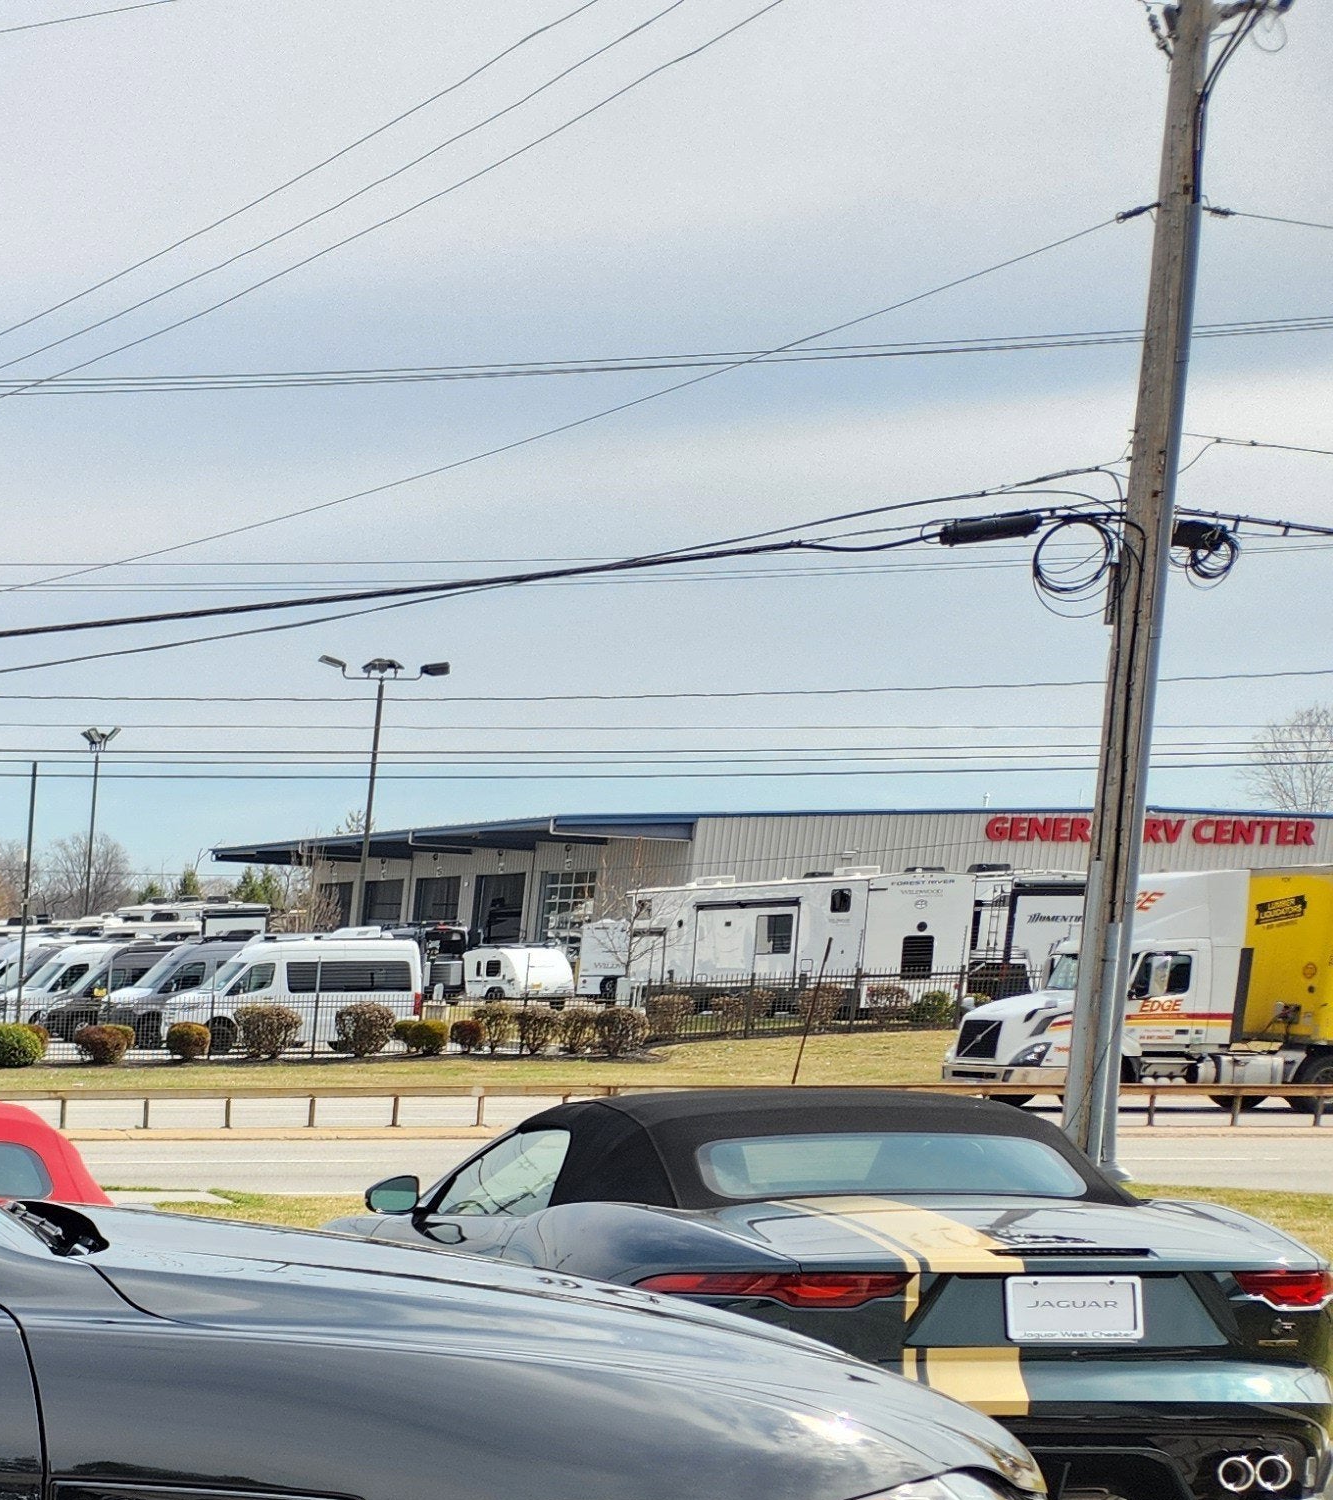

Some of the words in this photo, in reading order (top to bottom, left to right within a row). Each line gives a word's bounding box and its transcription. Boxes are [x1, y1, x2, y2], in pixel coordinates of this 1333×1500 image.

[985, 816, 1091, 842] GENER
[1191, 819, 1315, 846] CENTER
[1139, 999, 1183, 1013] EDGE
[1027, 1300, 1118, 1309] JAGUAR
[1020, 1331, 1057, 1339] Jaguar
